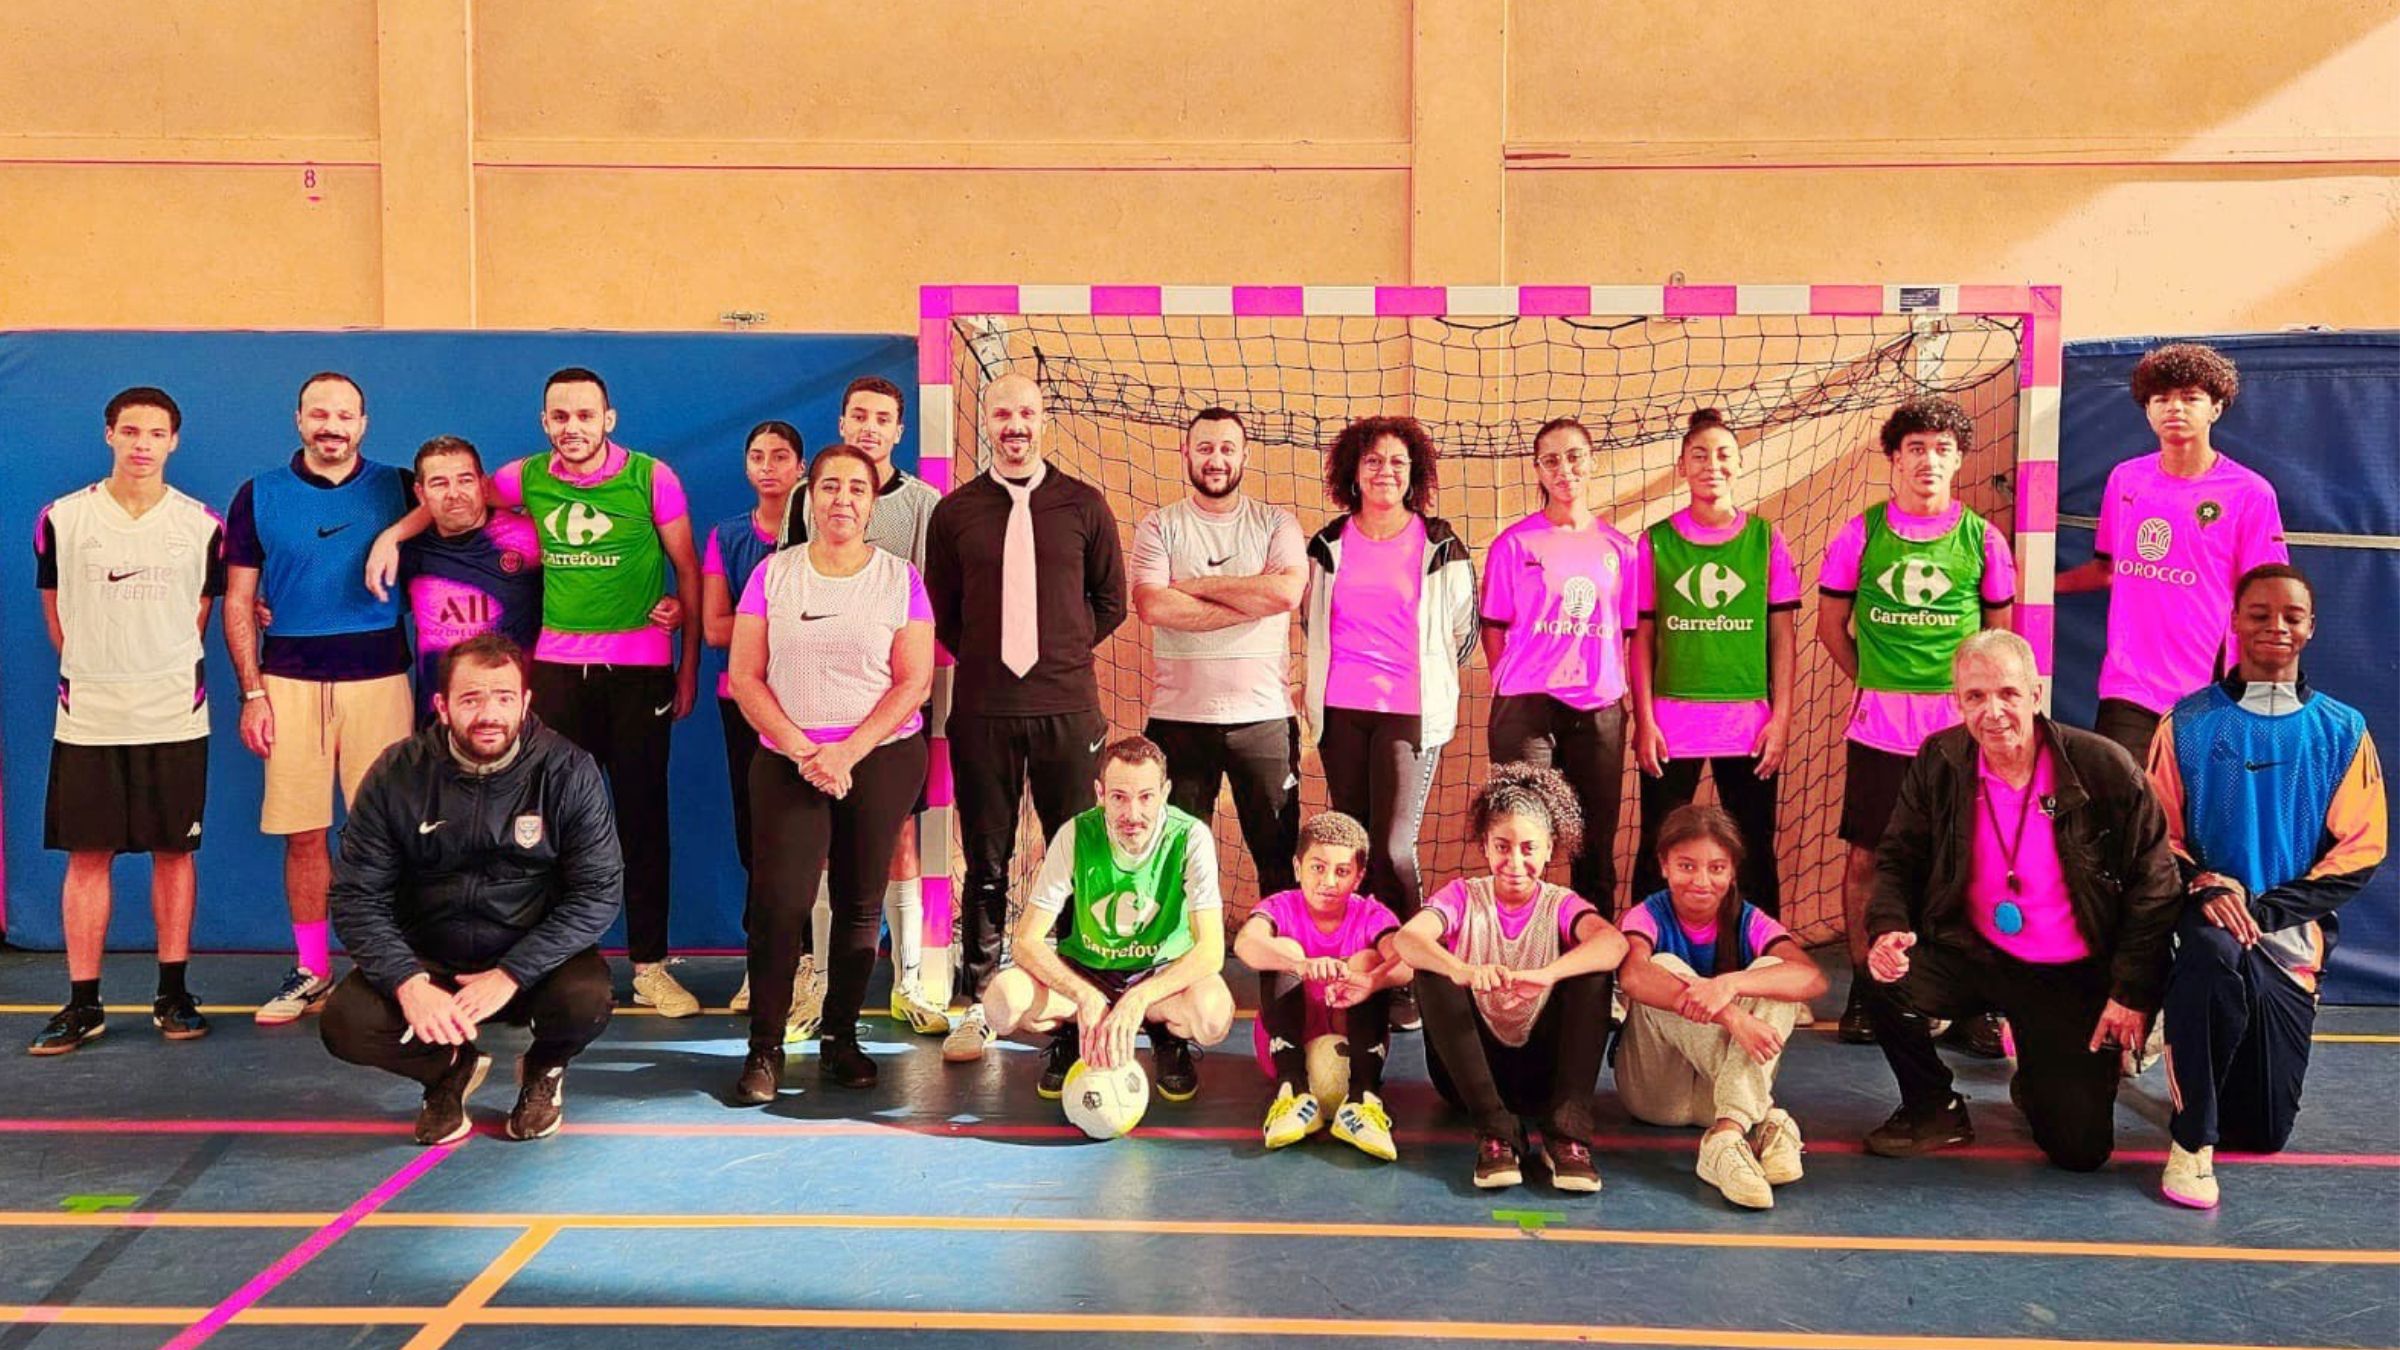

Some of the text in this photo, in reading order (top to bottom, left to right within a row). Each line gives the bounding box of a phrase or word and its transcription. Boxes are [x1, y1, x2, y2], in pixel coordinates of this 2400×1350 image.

[303, 168, 316, 189] 8
[2115, 559, 2197, 586] OROCCO
[1667, 614, 1754, 632] Carrefour
[1870, 606, 1959, 626] Carrefour
